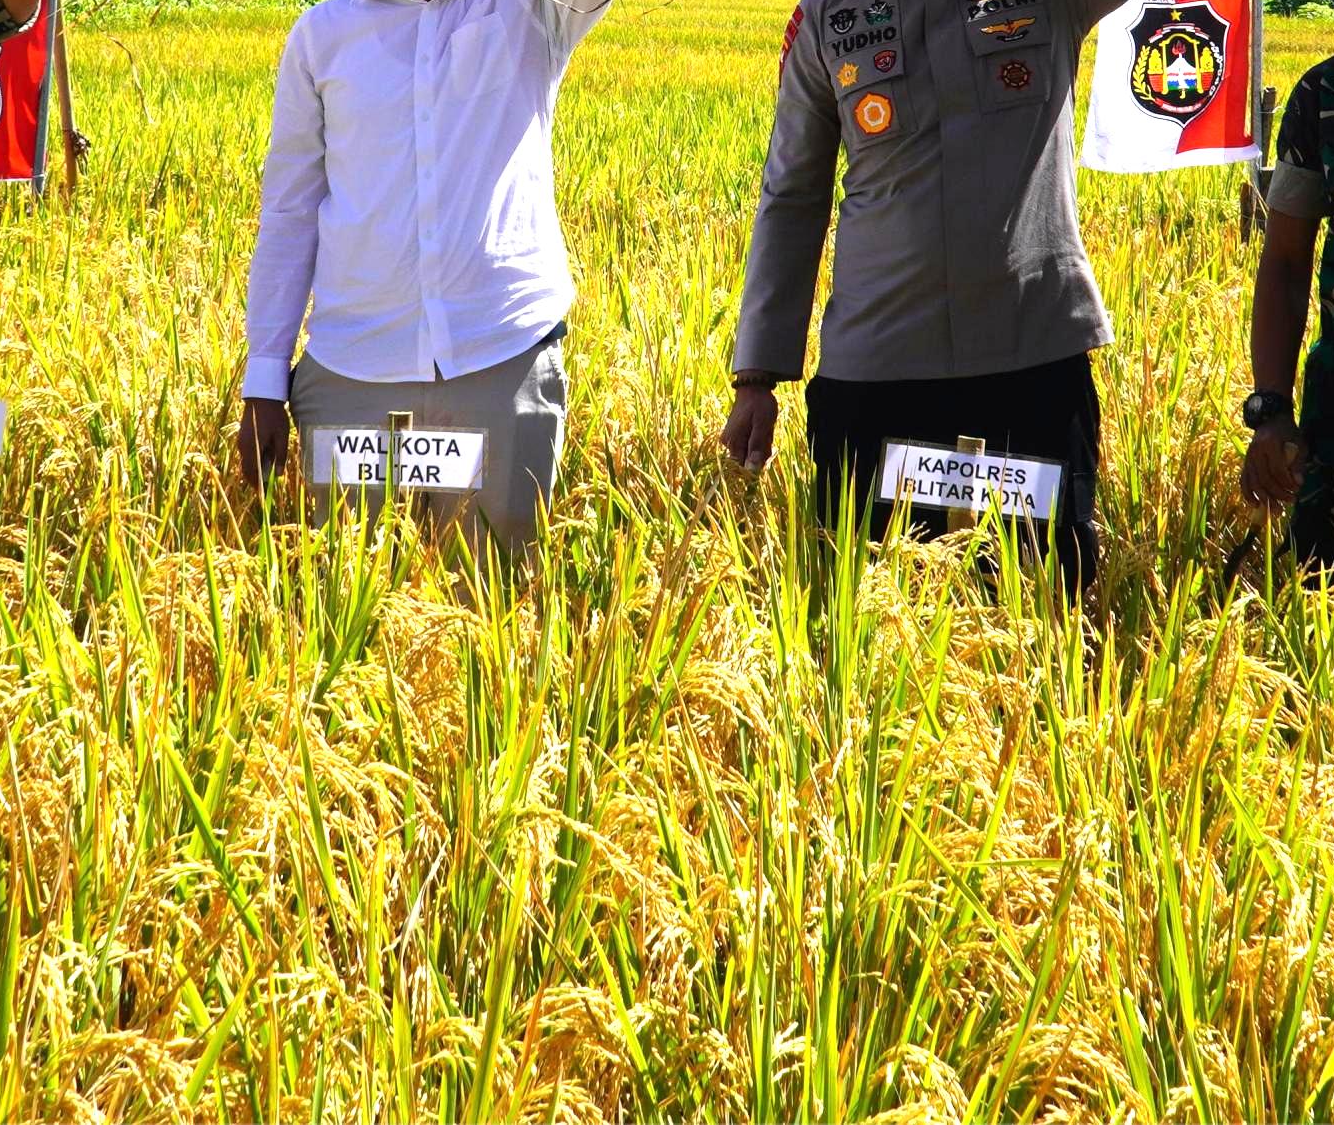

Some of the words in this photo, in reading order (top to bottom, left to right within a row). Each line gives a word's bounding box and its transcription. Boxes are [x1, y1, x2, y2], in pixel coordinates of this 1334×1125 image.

[831, 26, 897, 57] YUDHO
[358, 463, 441, 484] BLTAR
[918, 456, 1027, 485] KAPOLRES
[903, 477, 974, 501] BLITAR
